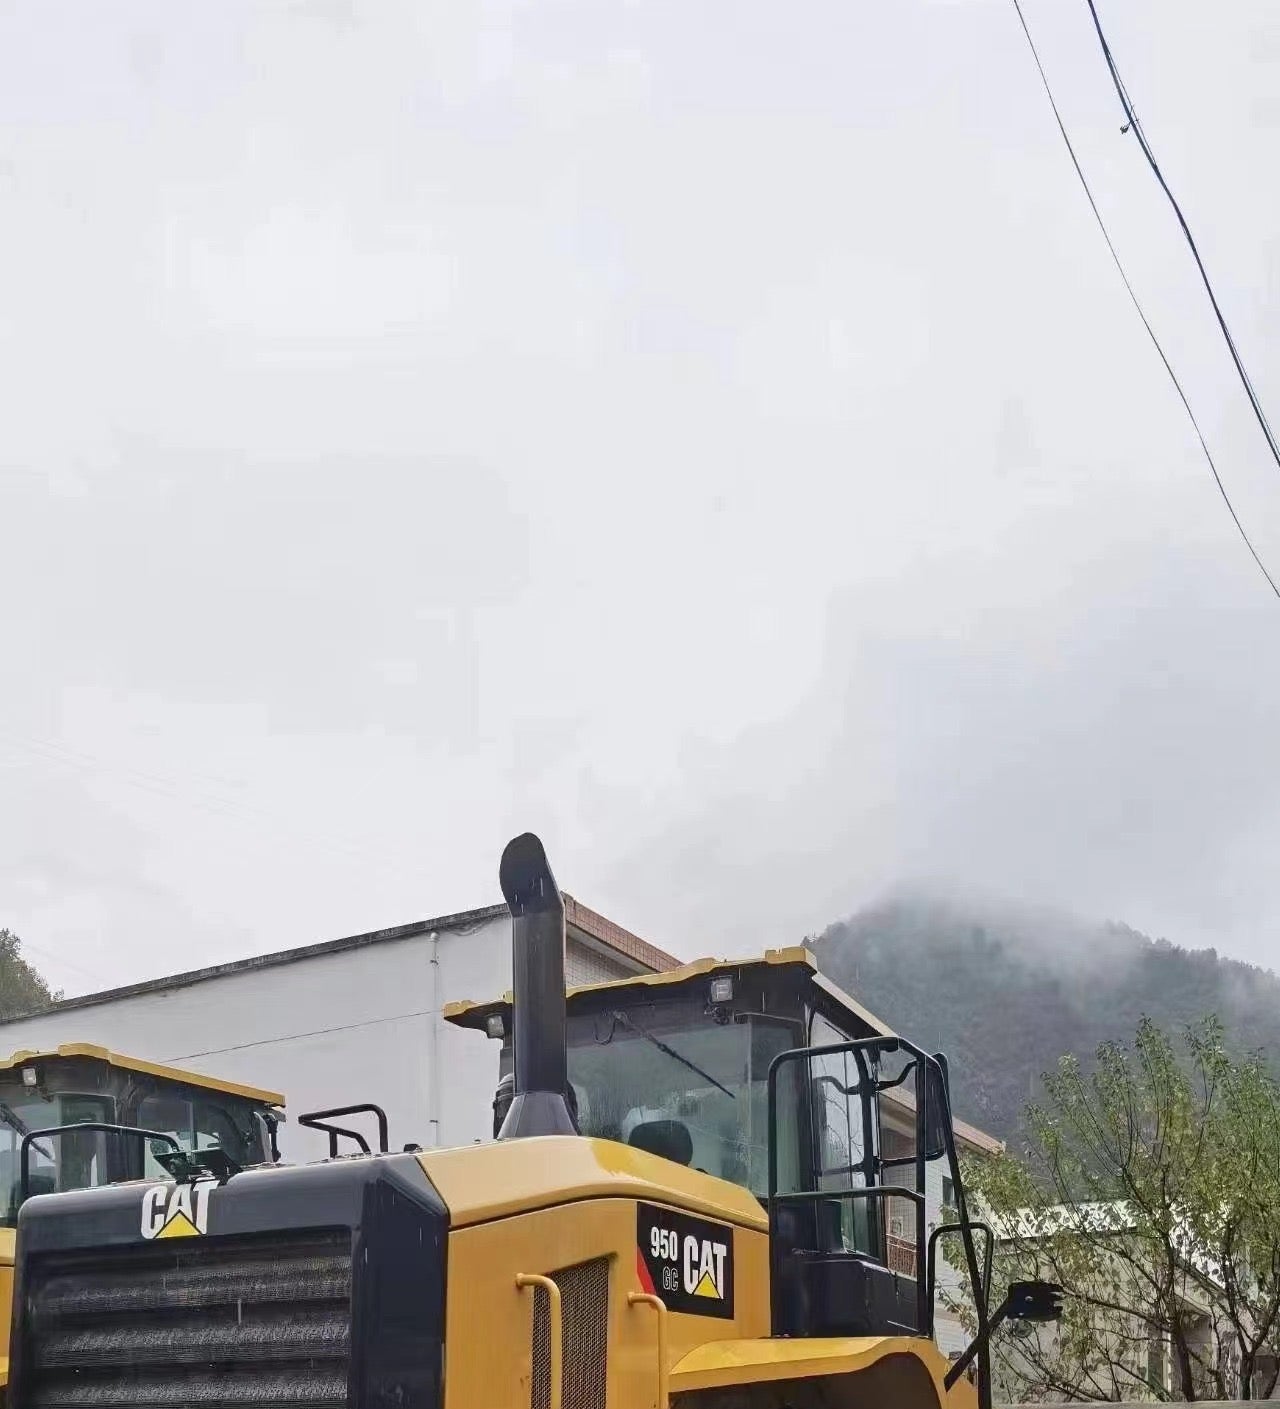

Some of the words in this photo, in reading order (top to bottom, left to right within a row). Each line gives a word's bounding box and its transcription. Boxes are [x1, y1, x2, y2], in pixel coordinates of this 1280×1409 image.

[141, 1181, 220, 1239] CAT
[650, 1227, 678, 1262] 950
[683, 1235, 727, 1300] CAT
[662, 1266, 679, 1291] GC
